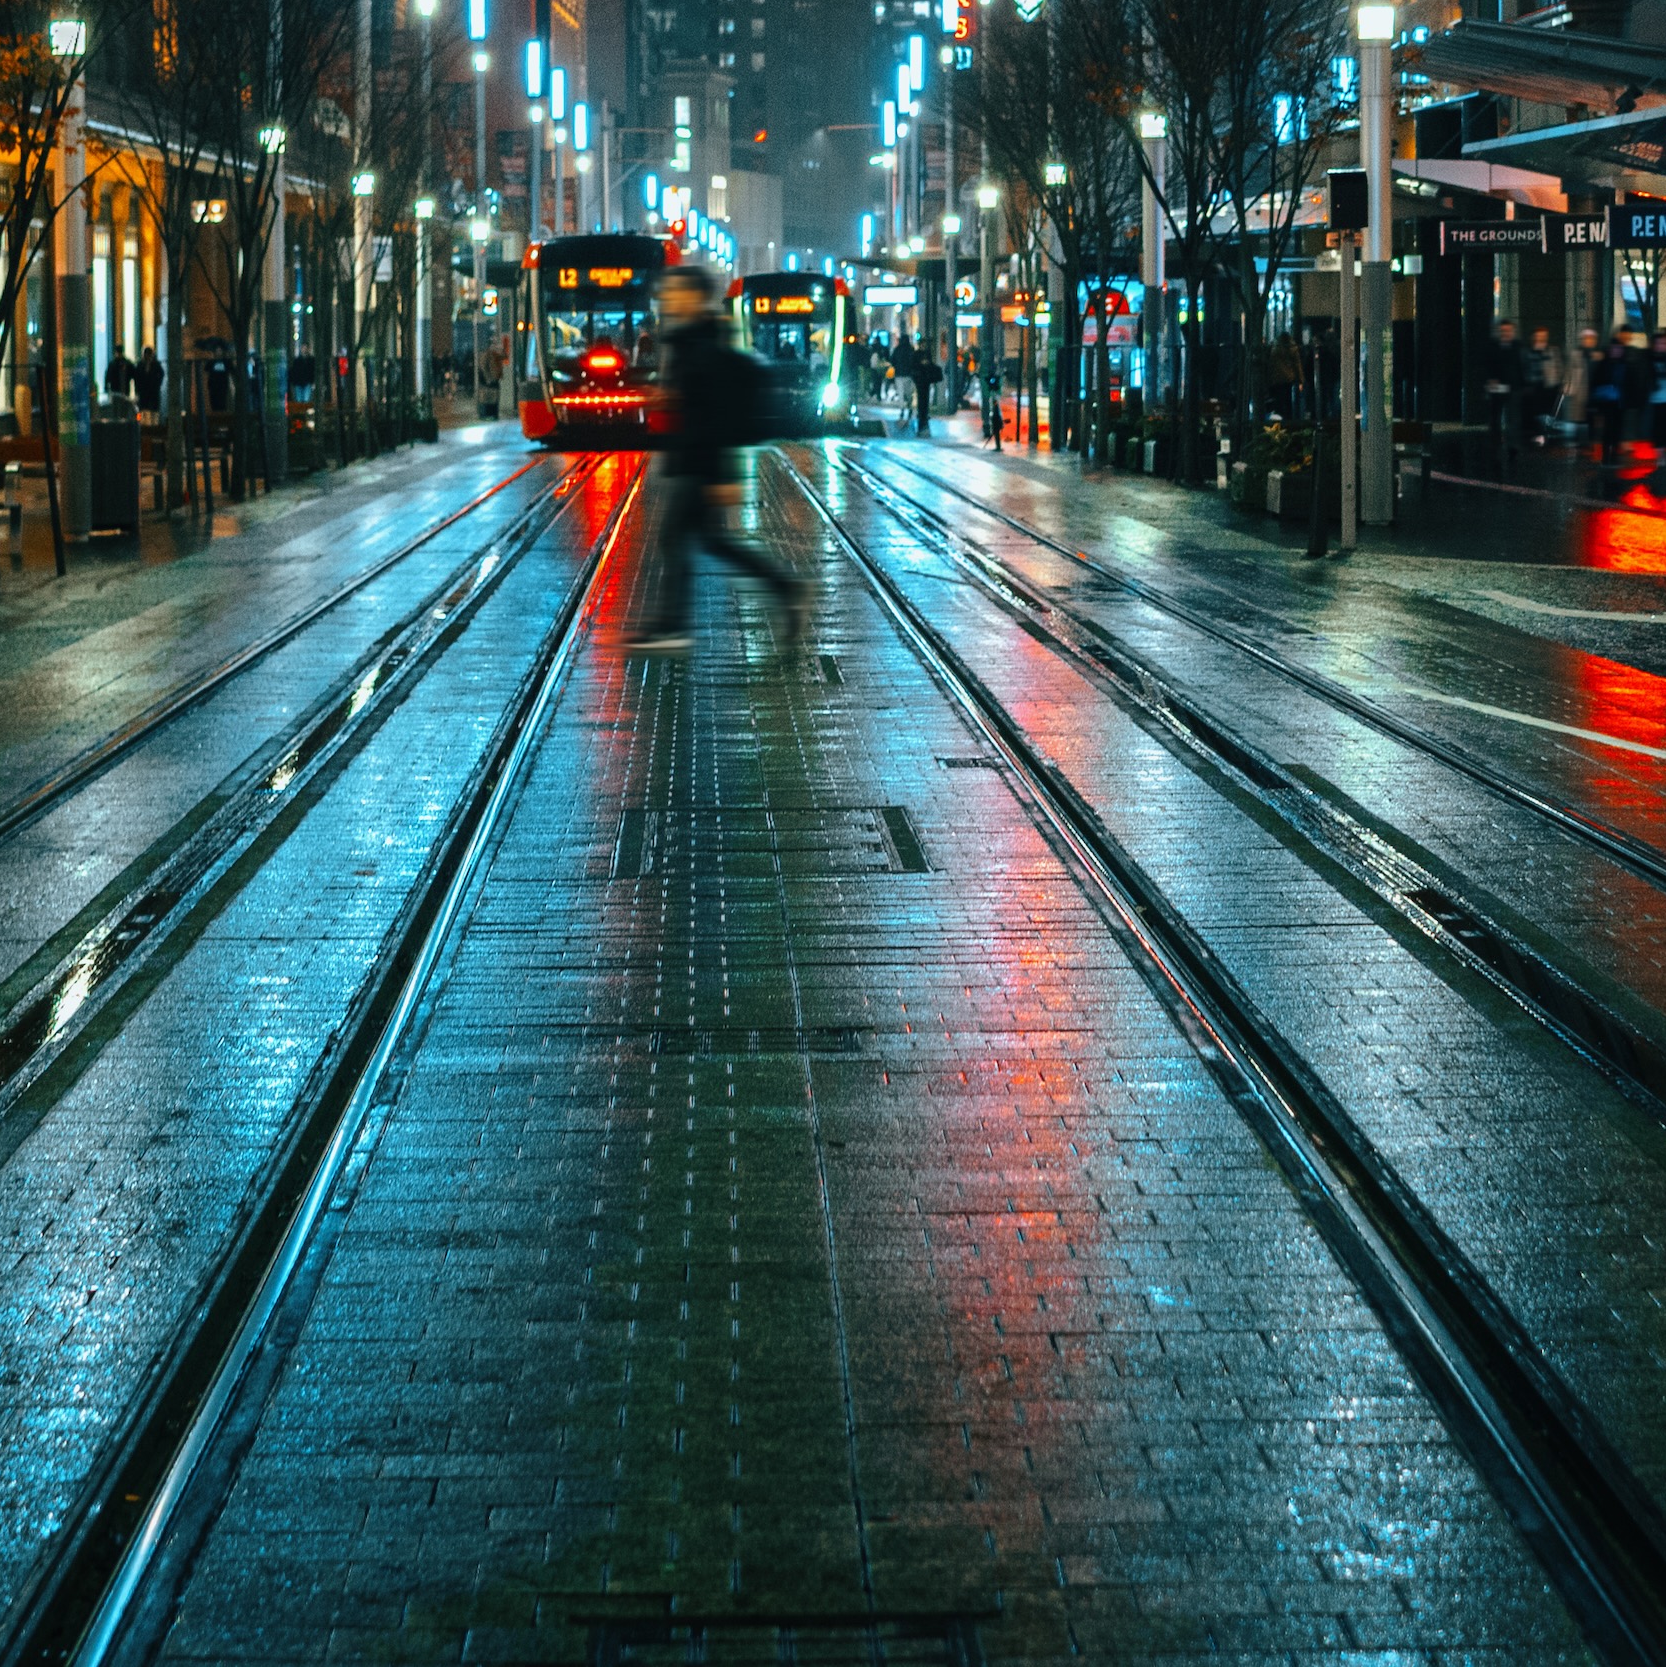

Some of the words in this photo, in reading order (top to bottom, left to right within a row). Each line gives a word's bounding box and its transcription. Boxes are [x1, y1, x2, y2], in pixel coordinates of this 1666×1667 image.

[1450, 229, 1476, 242] THE
[1479, 229, 1543, 242] GROUNDS
[559, 267, 578, 288] L2
[755, 297, 771, 313] L3
